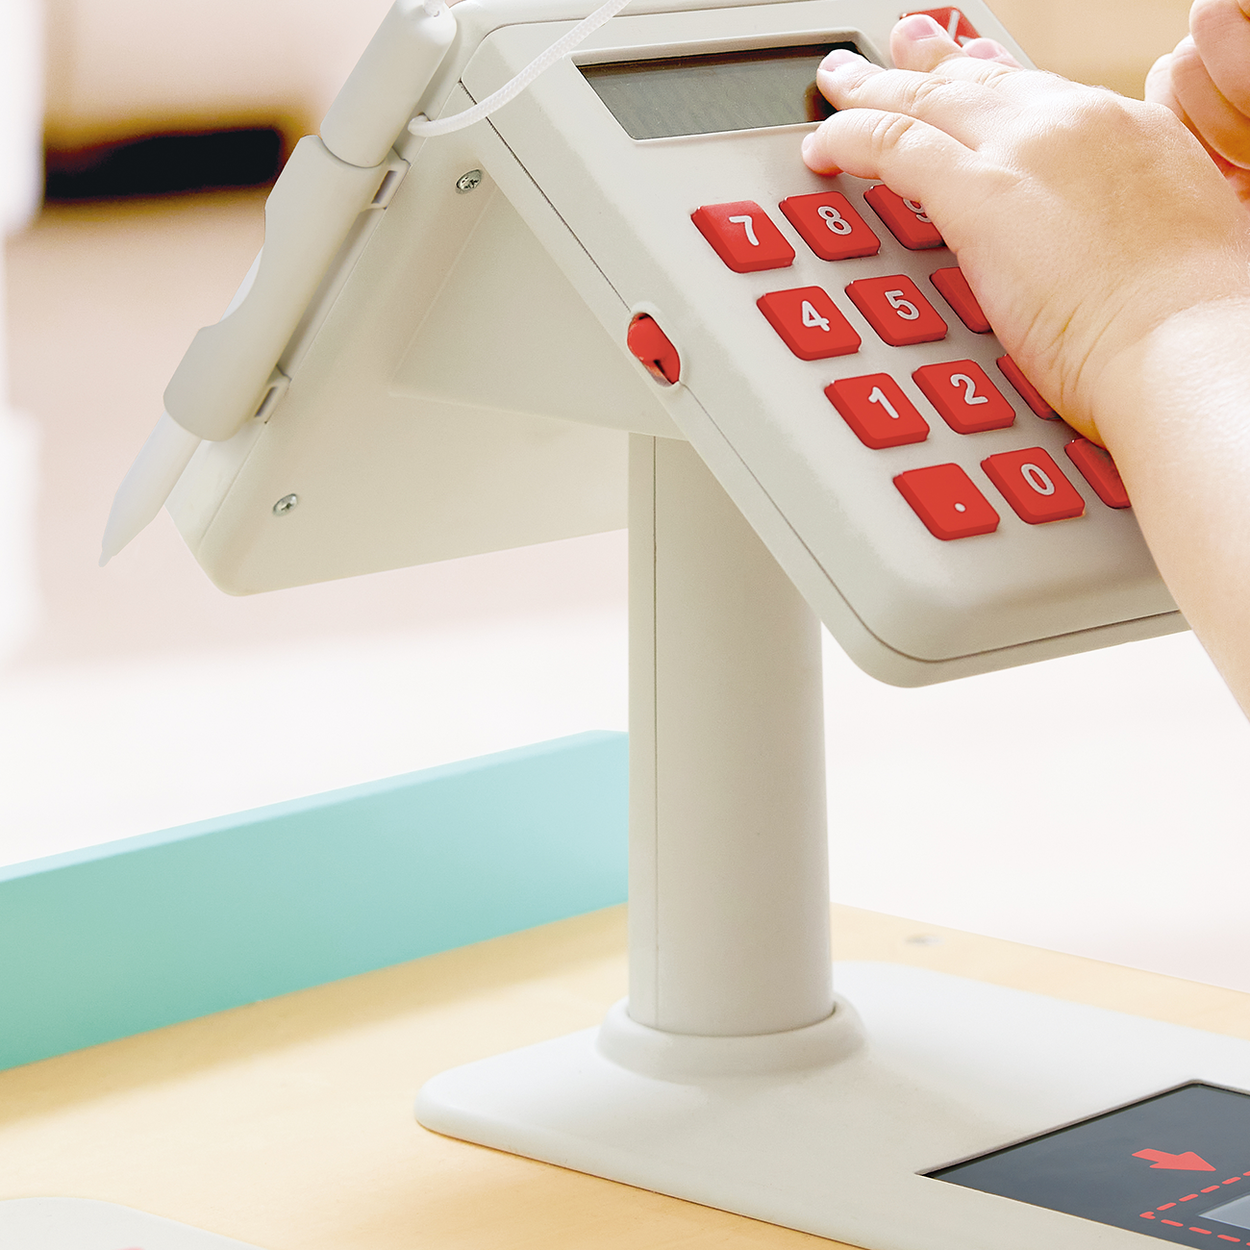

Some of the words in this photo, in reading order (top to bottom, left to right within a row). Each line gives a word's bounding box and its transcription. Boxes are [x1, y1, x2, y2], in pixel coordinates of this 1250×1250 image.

[728, 214, 760, 247] 7
[817, 205, 852, 236] 8
[801, 300, 831, 333] 4
[884, 289, 920, 320] 5
[868, 386, 900, 419] 1
[950, 373, 989, 405] 2
[1020, 463, 1055, 496] 0
